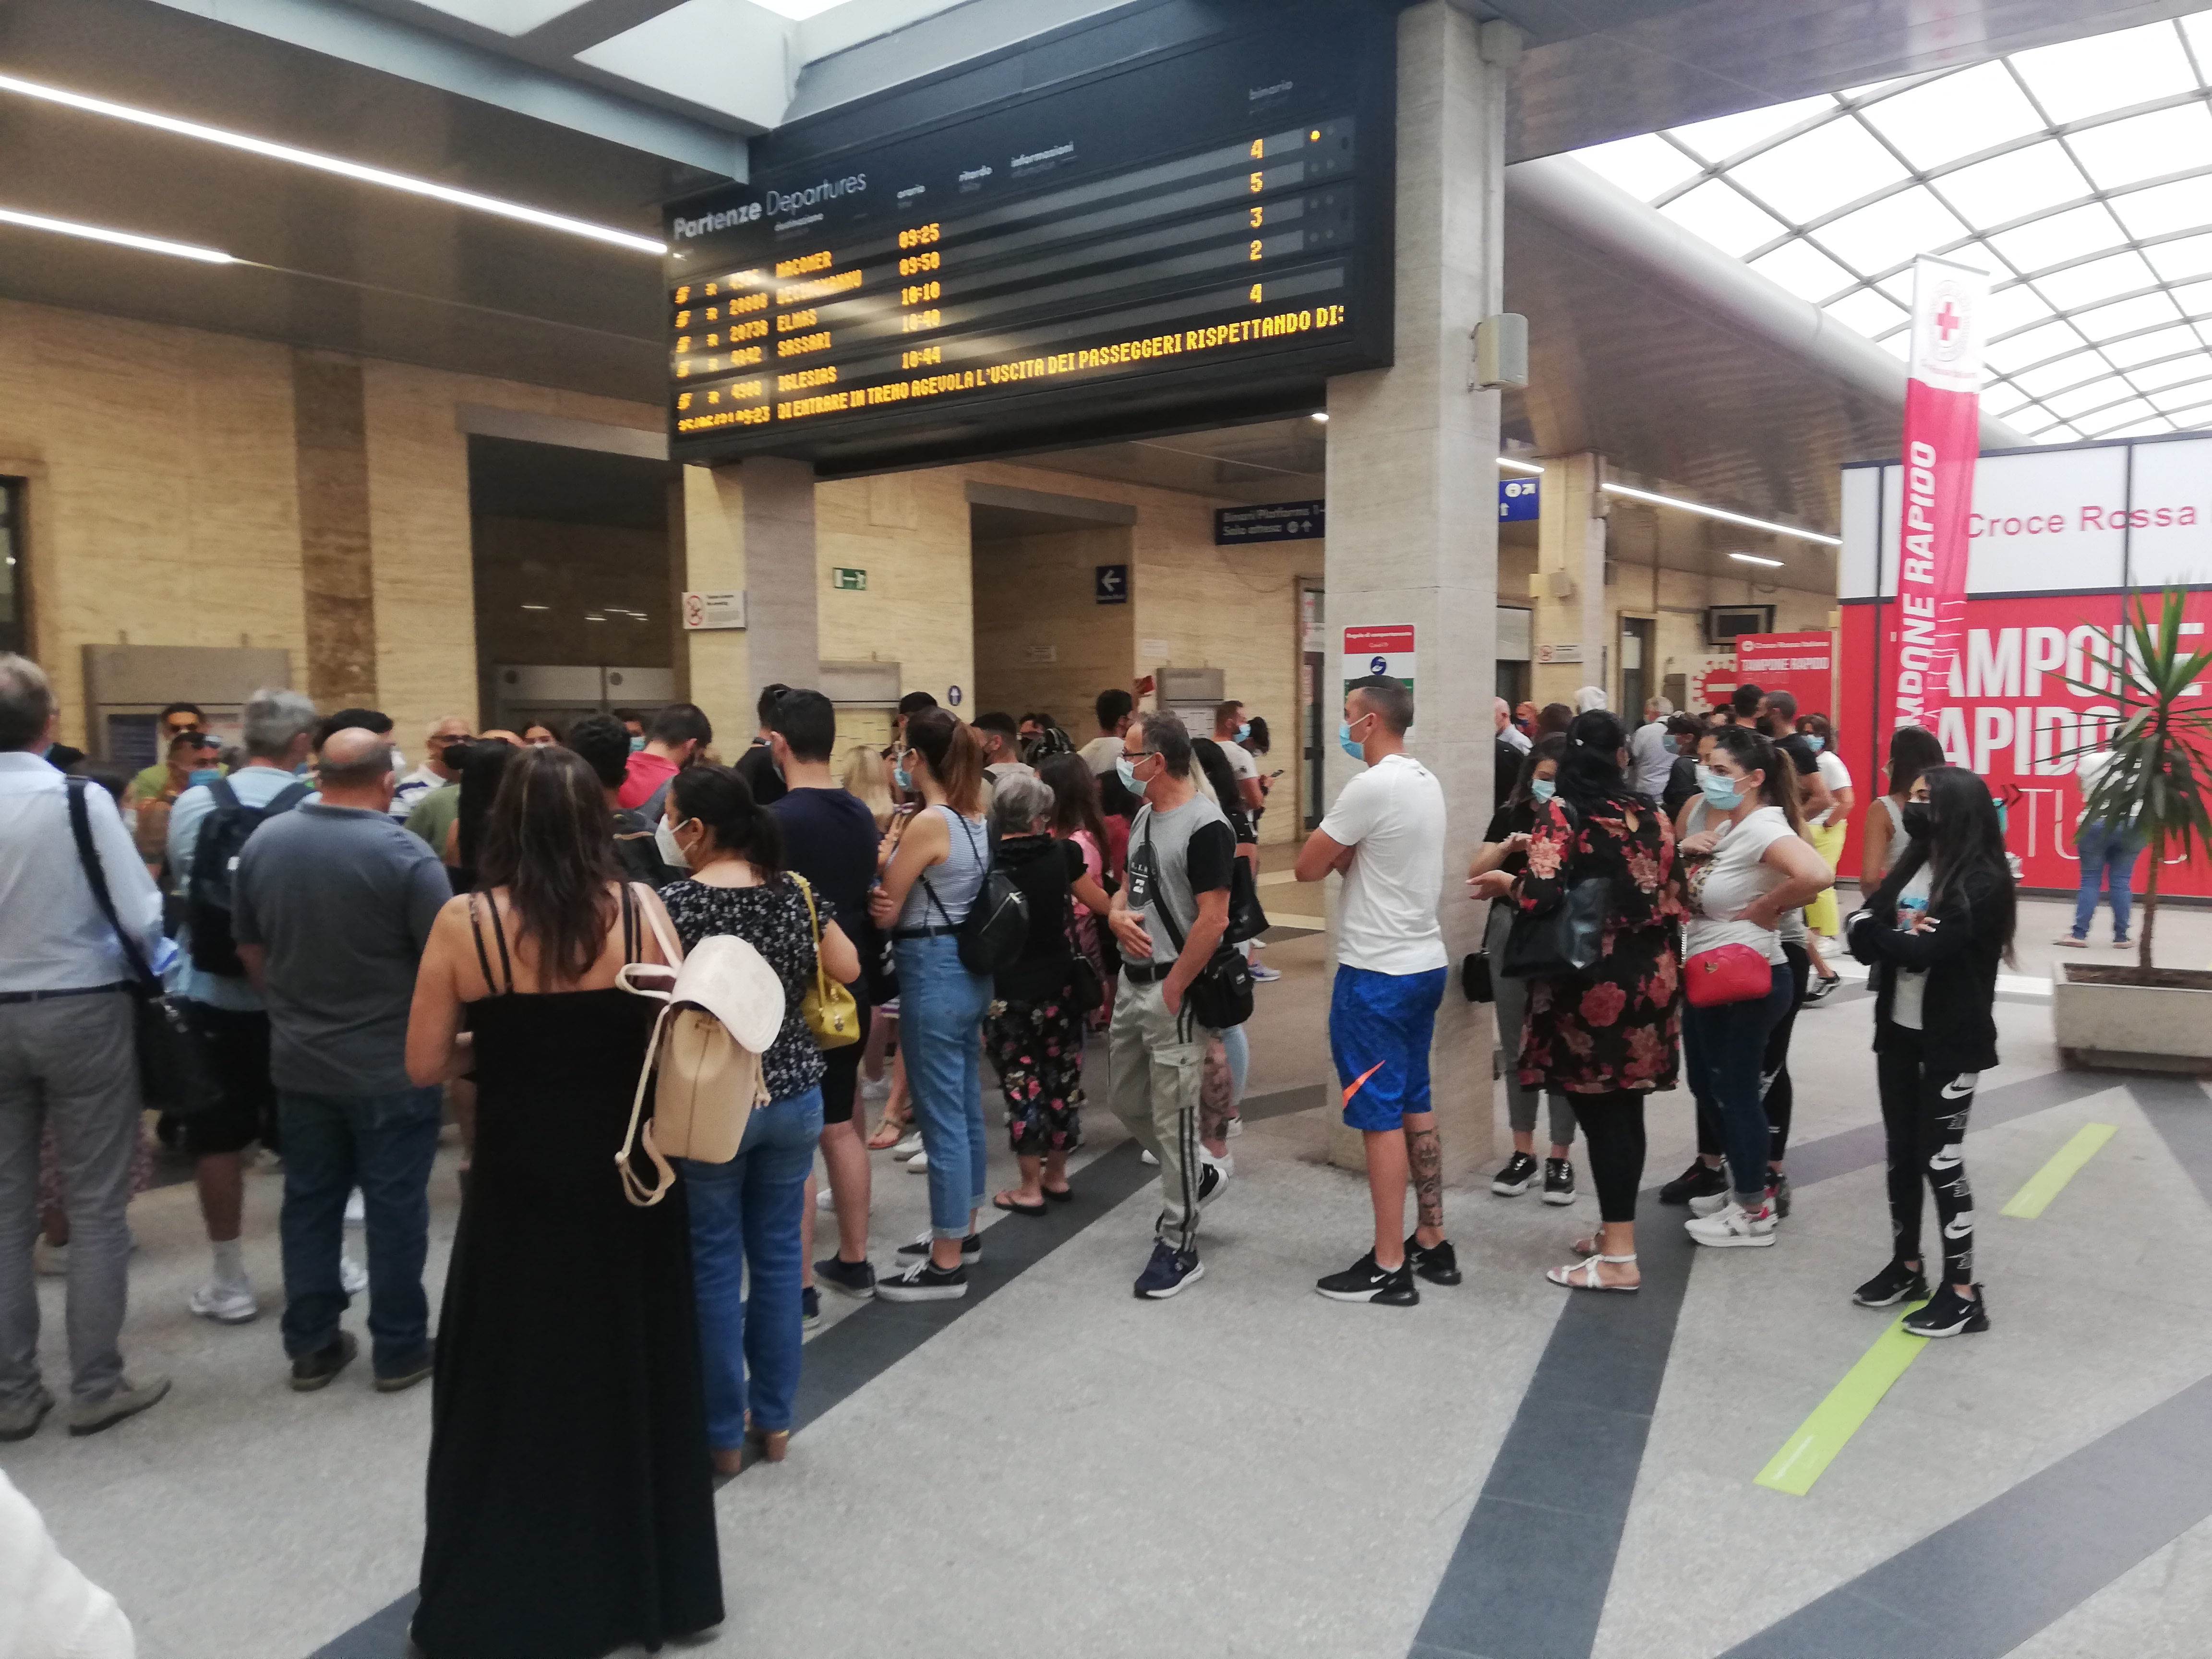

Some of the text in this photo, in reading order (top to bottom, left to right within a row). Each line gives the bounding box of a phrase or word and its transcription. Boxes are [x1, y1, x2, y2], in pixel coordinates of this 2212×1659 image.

[1250, 139, 1263, 159] 4
[1250, 172, 1263, 193] 5
[673, 202, 763, 240] Partenze
[766, 173, 867, 216] Departures
[1250, 206, 1263, 228] 3
[1250, 240, 1262, 261] 2
[1250, 283, 1262, 303] 4
[850, 389, 866, 408] IN
[911, 371, 974, 397] AGEVOLA
[1047, 352, 1075, 374] DEI
[1078, 333, 1182, 369] PASSEGGERI
[1186, 311, 1310, 350] RISPETTANDO
[1904, 440, 1936, 585] RAPIDO
[1967, 505, 2197, 538] Croce Rossa
[1894, 593, 1936, 729] MPONE
